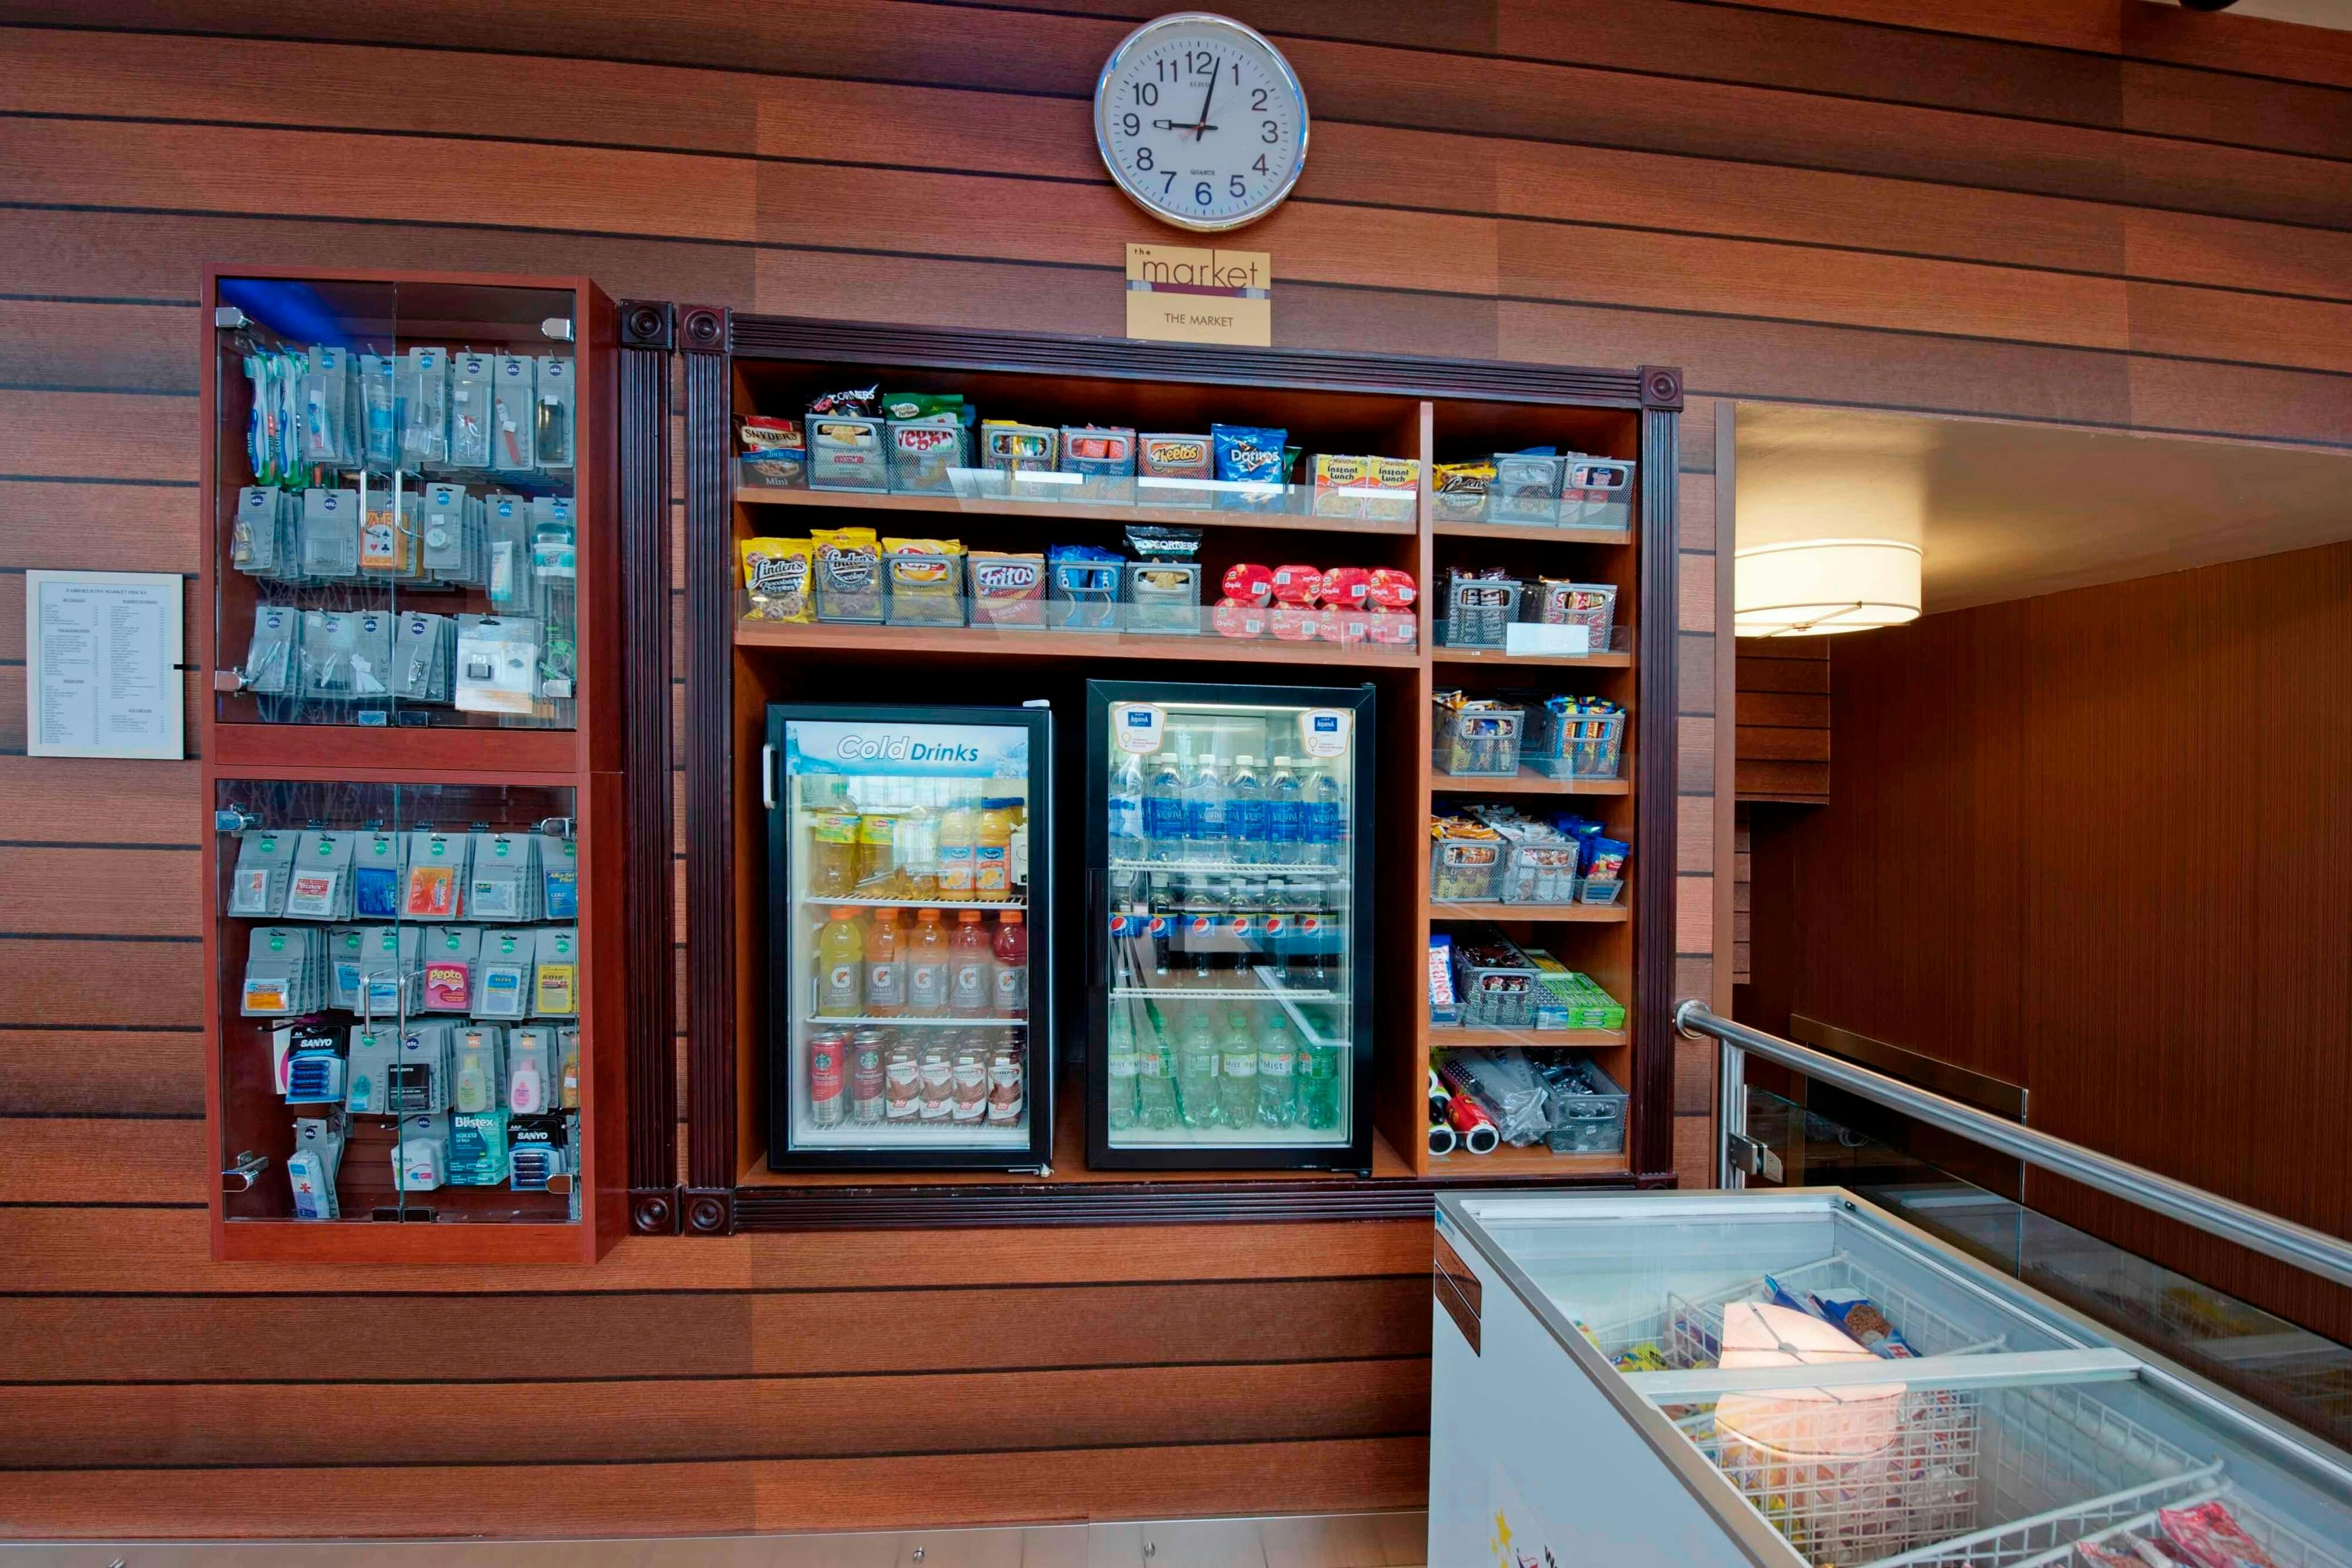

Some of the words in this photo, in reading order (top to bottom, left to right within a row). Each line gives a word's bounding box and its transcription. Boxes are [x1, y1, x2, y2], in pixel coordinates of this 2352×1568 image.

[1156, 59, 1178, 83] 11
[1186, 51, 1212, 74] 12
[1232, 63, 1240, 86] 1
[1132, 82, 1158, 106] 10
[1251, 88, 1268, 112] 2
[1124, 113, 1140, 136] 9
[1262, 121, 1278, 143] 3
[1136, 148, 1154, 171] 8
[1252, 153, 1268, 176] 4
[1160, 170, 1177, 194] 7
[1230, 175, 1245, 198] 5
[1196, 182, 1212, 205] 6
[1143, 249, 1258, 288] market
[1164, 313, 1185, 324] THE
[1190, 315, 1234, 327] MARKET
[1151, 445, 1198, 463] Cheetos
[1231, 449, 1280, 462] Doritos
[1327, 465, 1358, 474] Instant
[1379, 468, 1409, 477] Instant
[766, 477, 788, 486] Mini
[750, 559, 807, 584] Linden's
[980, 567, 1033, 586] Fritos
[837, 734, 910, 761] Cold
[911, 743, 978, 762] Drinks
[270, 862, 288, 914] health
[429, 969, 462, 981] pepto
[831, 966, 850, 988] G
[872, 966, 891, 988] G
[914, 968, 931, 989] G
[959, 968, 977, 989] G
[999, 971, 1016, 991] G
[300, 1038, 333, 1048] SANYO
[1263, 1060, 1284, 1070] Mist
[455, 1116, 495, 1127] Blistex
[517, 1132, 548, 1140] SANYO
